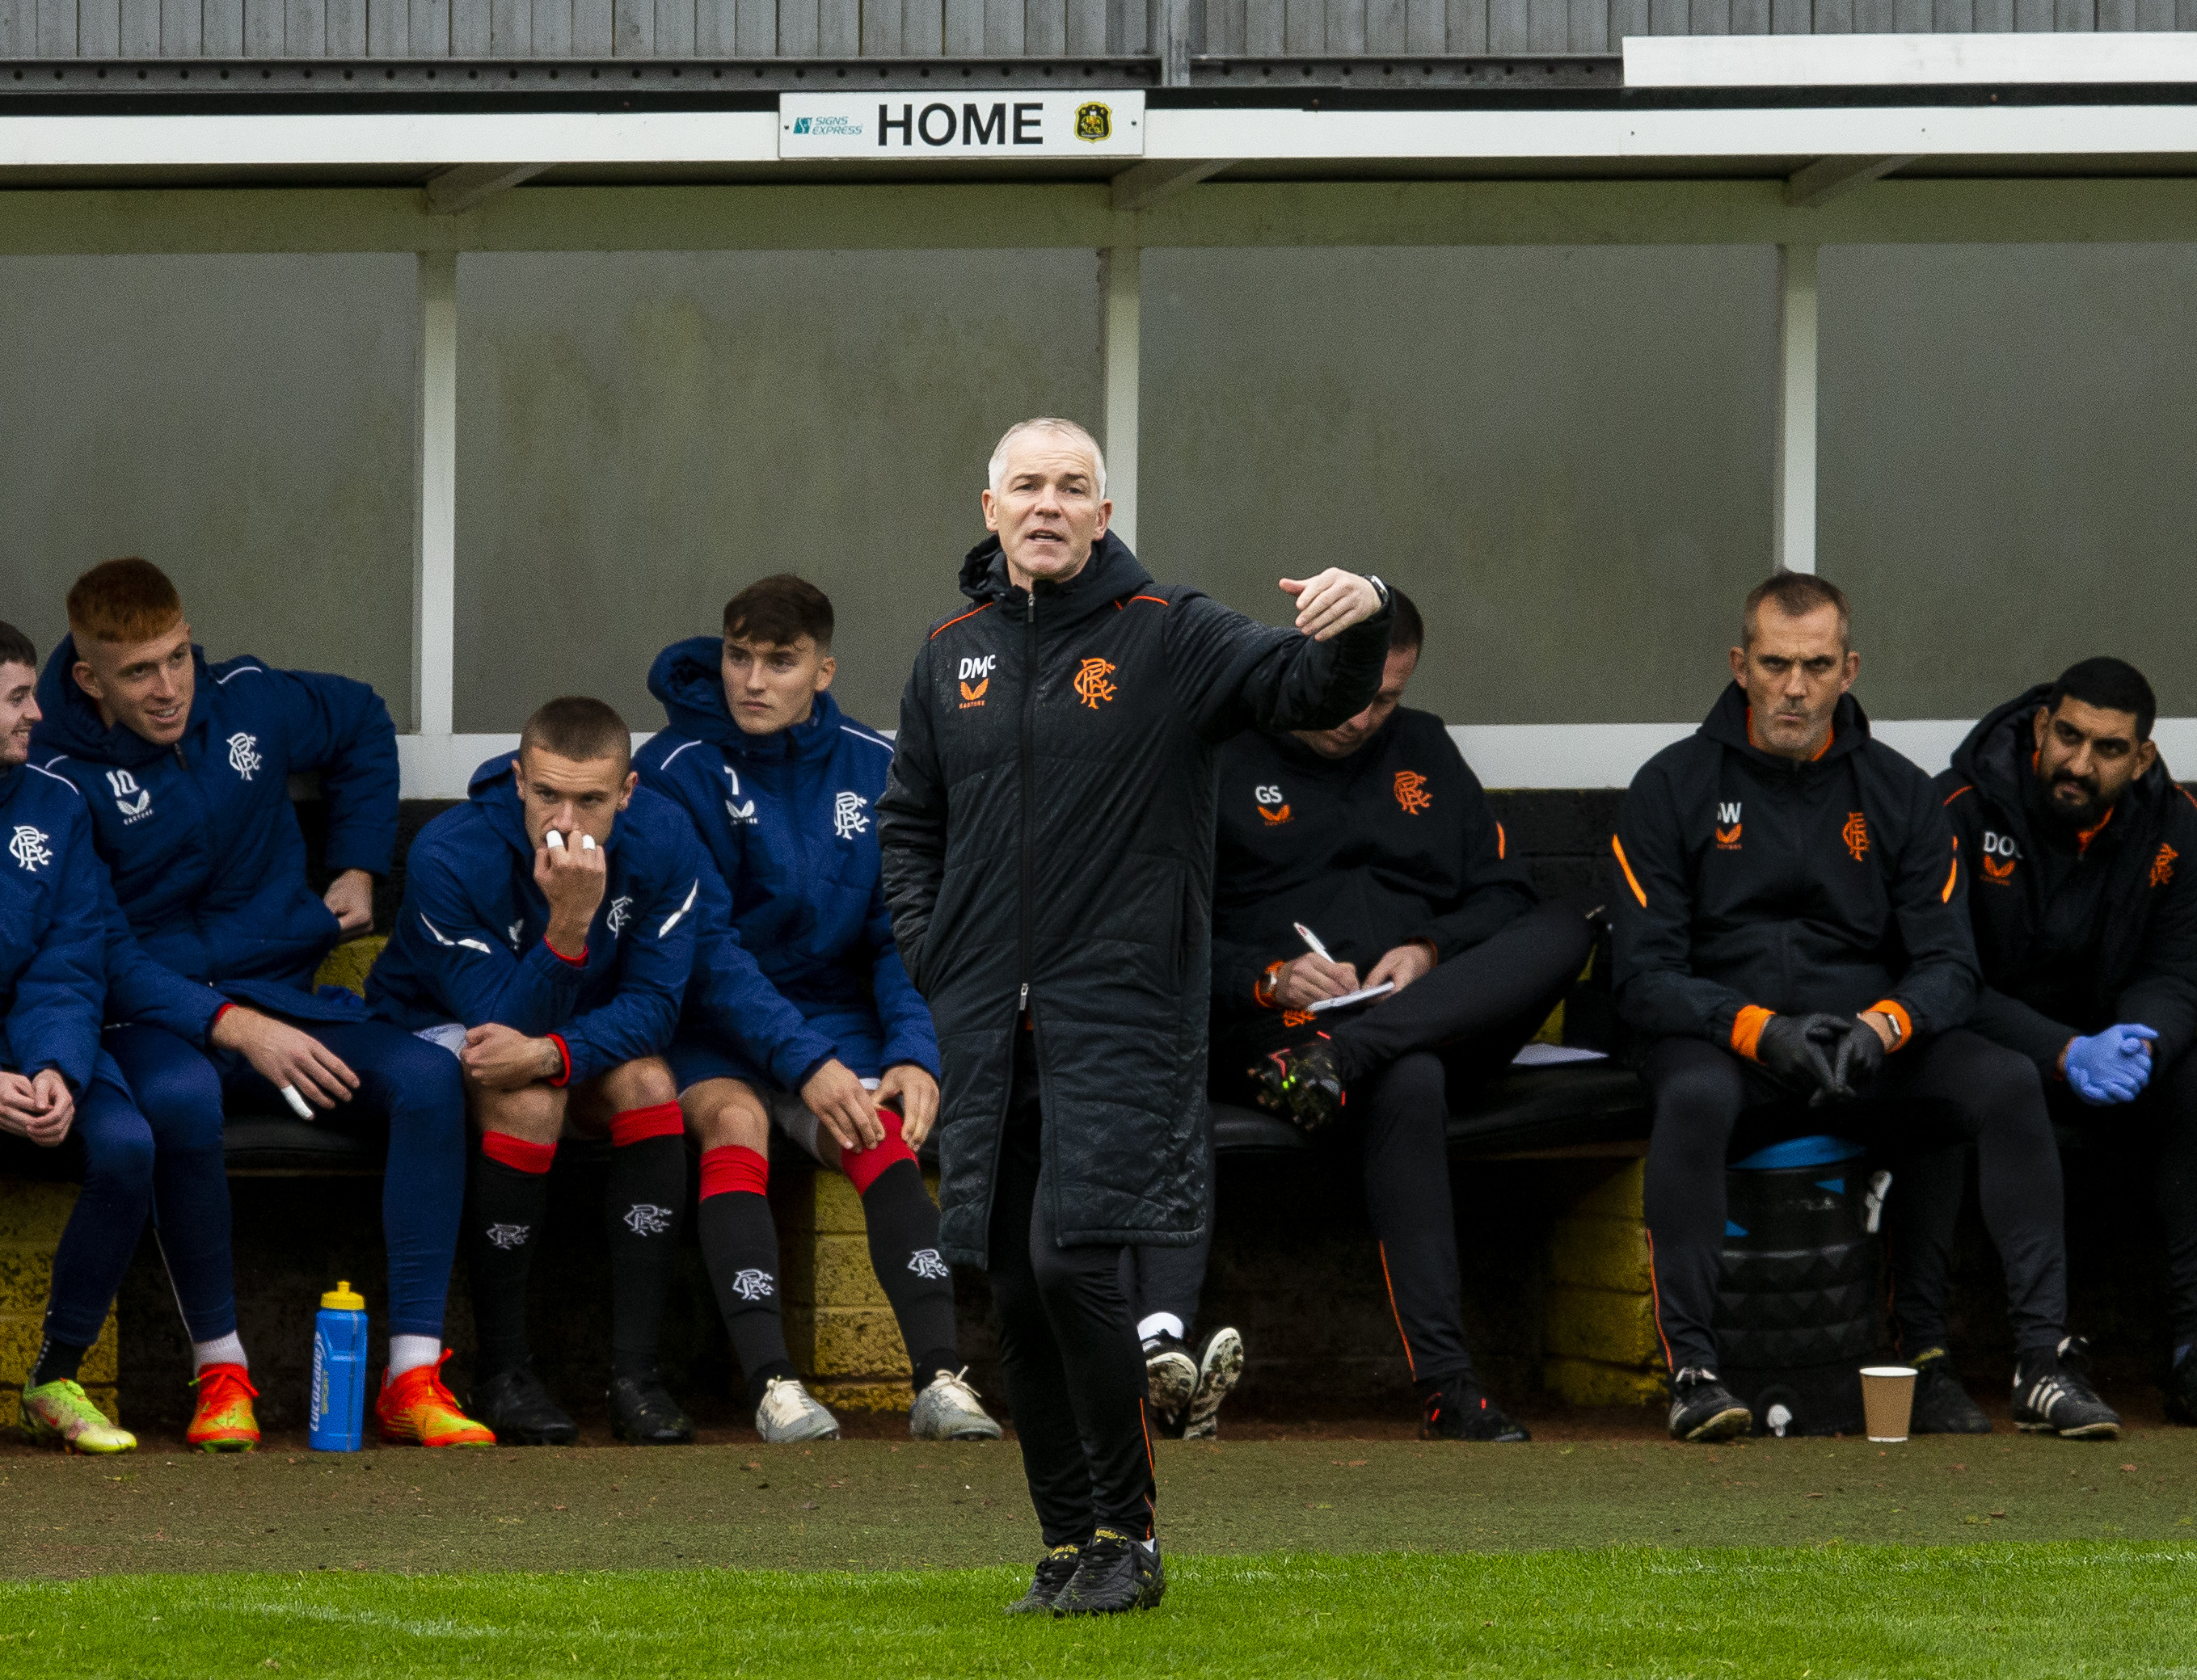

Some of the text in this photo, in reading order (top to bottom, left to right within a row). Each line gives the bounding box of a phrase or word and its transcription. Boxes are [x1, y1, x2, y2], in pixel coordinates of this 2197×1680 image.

[812, 124, 862, 135] EXPRESS
[815, 116, 848, 125] SIGNS
[878, 103, 1044, 145] HOME
[106, 769, 139, 797] 10
[1255, 785, 1283, 803] GS
[1984, 831, 2023, 859] DO
